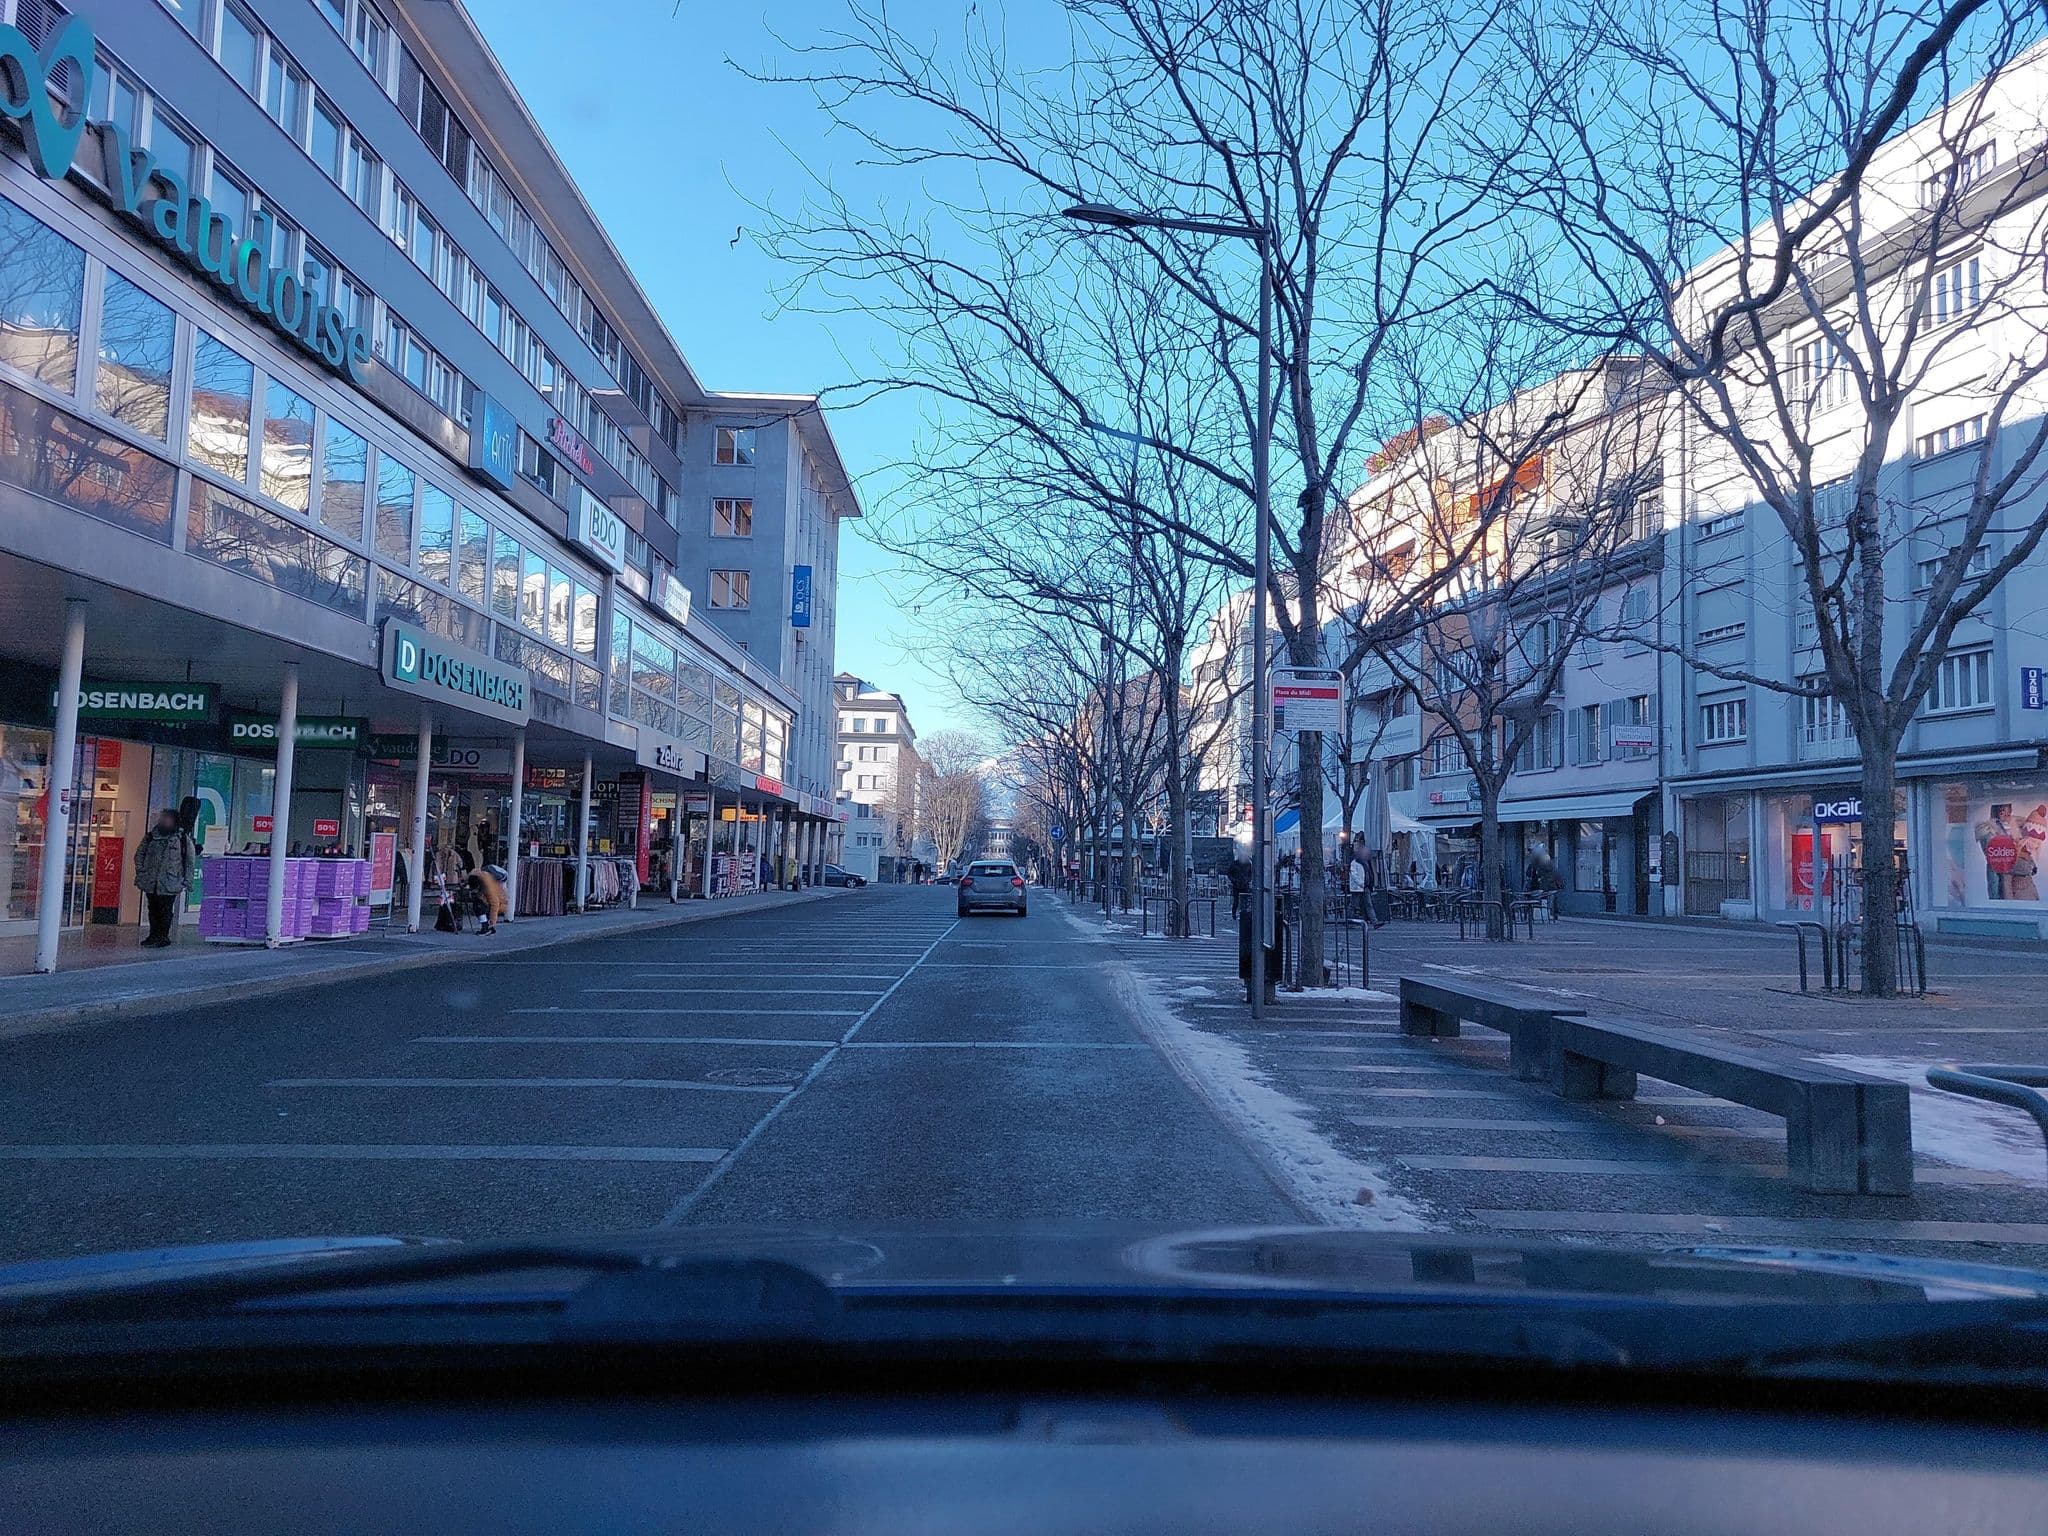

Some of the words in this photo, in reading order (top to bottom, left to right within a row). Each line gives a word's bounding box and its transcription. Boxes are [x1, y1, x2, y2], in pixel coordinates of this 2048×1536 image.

[110, 120, 372, 386] vaudoise
[590, 505, 617, 551] BDO
[422, 648, 524, 711] DOSENBACH
[53, 691, 204, 711] OSENBACH
[233, 723, 356, 740] DOSBACH
[382, 742, 442, 755] vaude
[658, 746, 684, 772] zebra
[317, 823, 336, 832] 50%
[1987, 846, 2015, 857] Soldes
